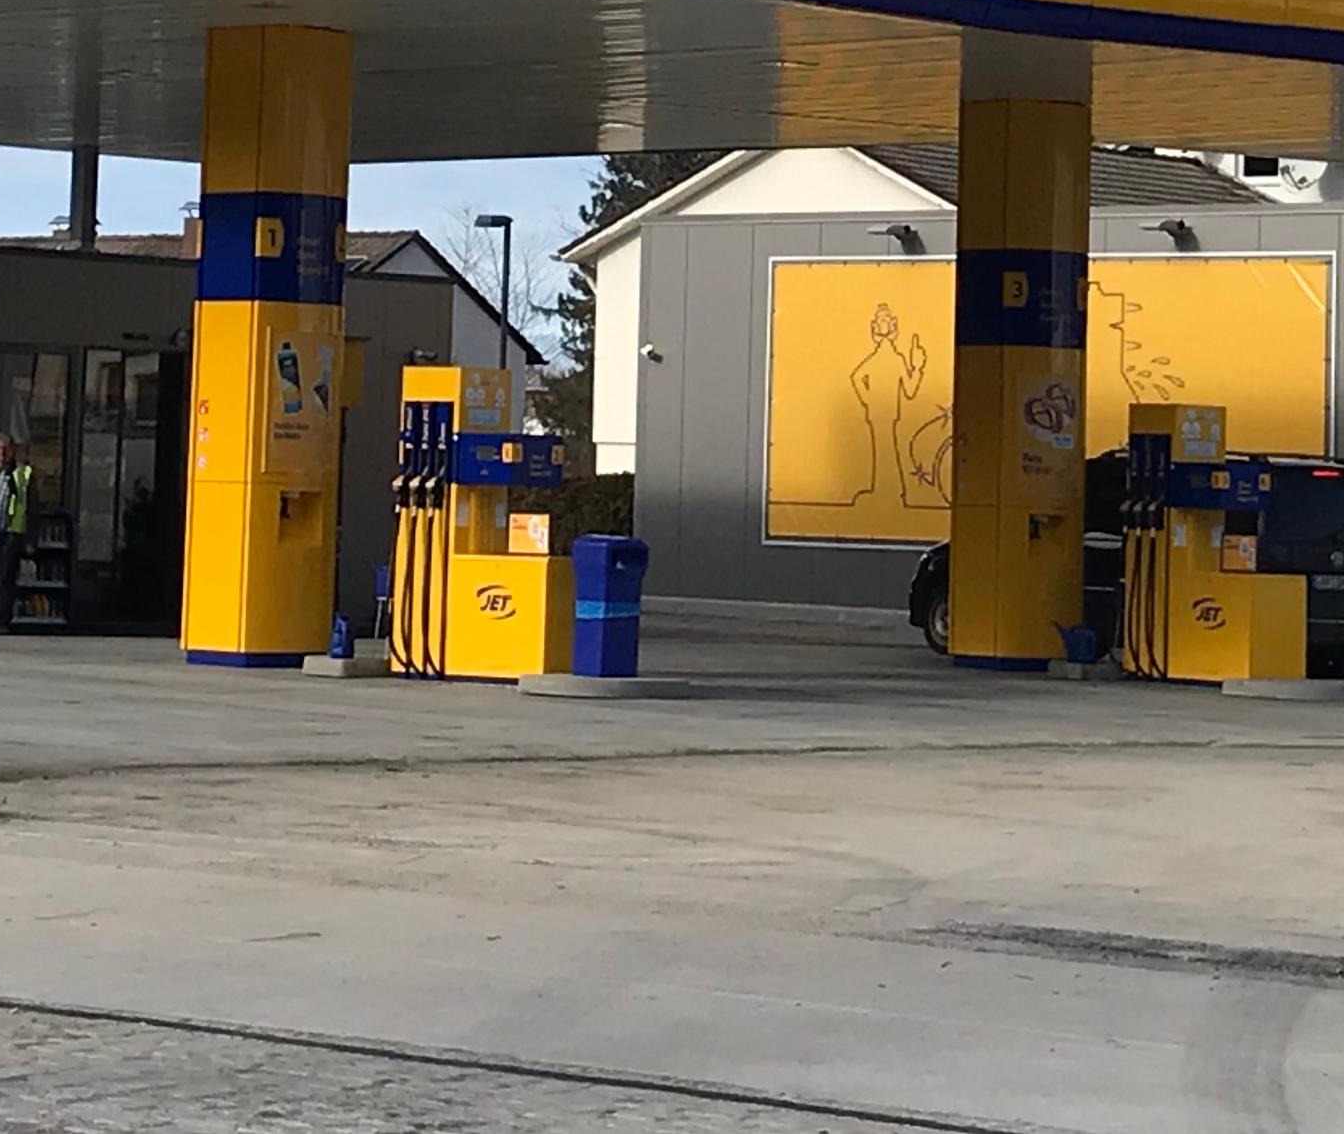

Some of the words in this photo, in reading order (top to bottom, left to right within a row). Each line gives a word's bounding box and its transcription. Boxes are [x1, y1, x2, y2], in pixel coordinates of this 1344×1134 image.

[268, 229, 276, 247] 1
[1012, 281, 1023, 298] 3
[480, 595, 512, 612] JET
[1196, 607, 1222, 623] JET
